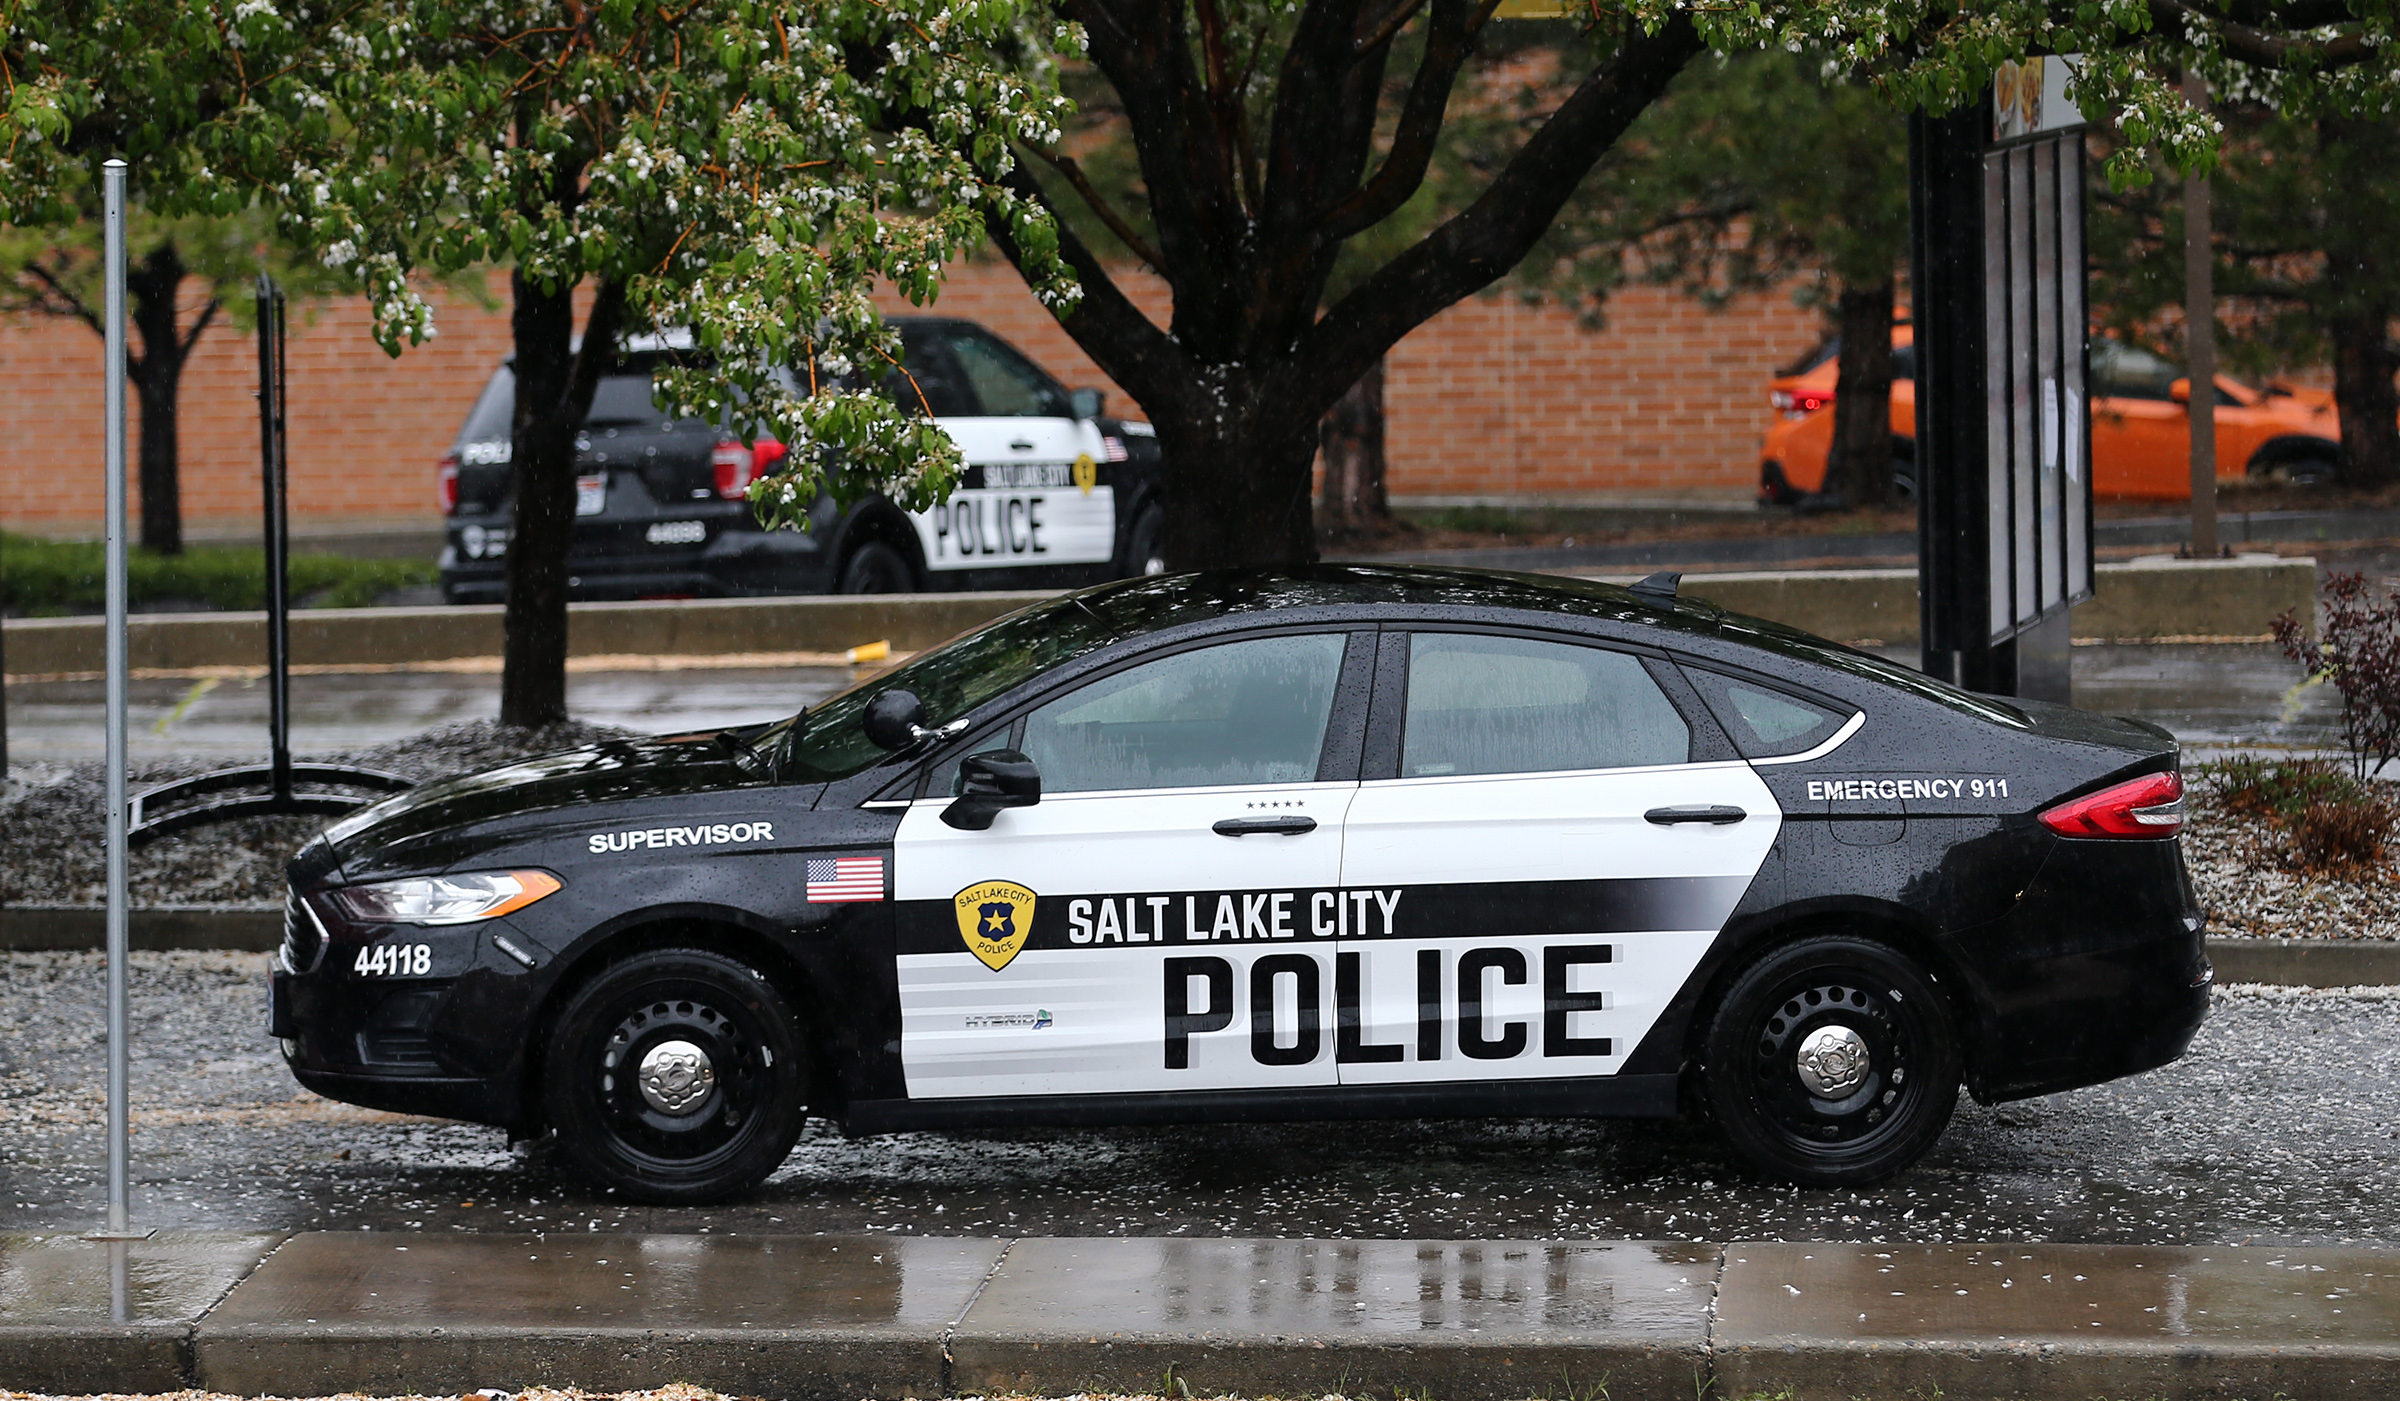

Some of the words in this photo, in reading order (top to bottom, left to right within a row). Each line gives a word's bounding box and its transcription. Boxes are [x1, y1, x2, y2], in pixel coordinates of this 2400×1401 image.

[462, 441, 513, 466] POLI
[936, 498, 1047, 556] POLICE
[1806, 779, 1964, 801] EMERGENCY
[1970, 778, 2009, 798] 911
[588, 822, 775, 854] SUPERVISOR
[959, 890, 981, 908] SALT
[983, 888, 1009, 899] LAKE
[1010, 890, 1032, 904] CITY
[1068, 896, 1170, 944] SALT
[1186, 893, 1295, 941] LAKE
[1311, 889, 1402, 937] CITY
[354, 944, 432, 977] 44118
[977, 941, 1014, 954] POLICE
[1164, 944, 1613, 1069] POLICE
[965, 1014, 1035, 1028] HYBRID
